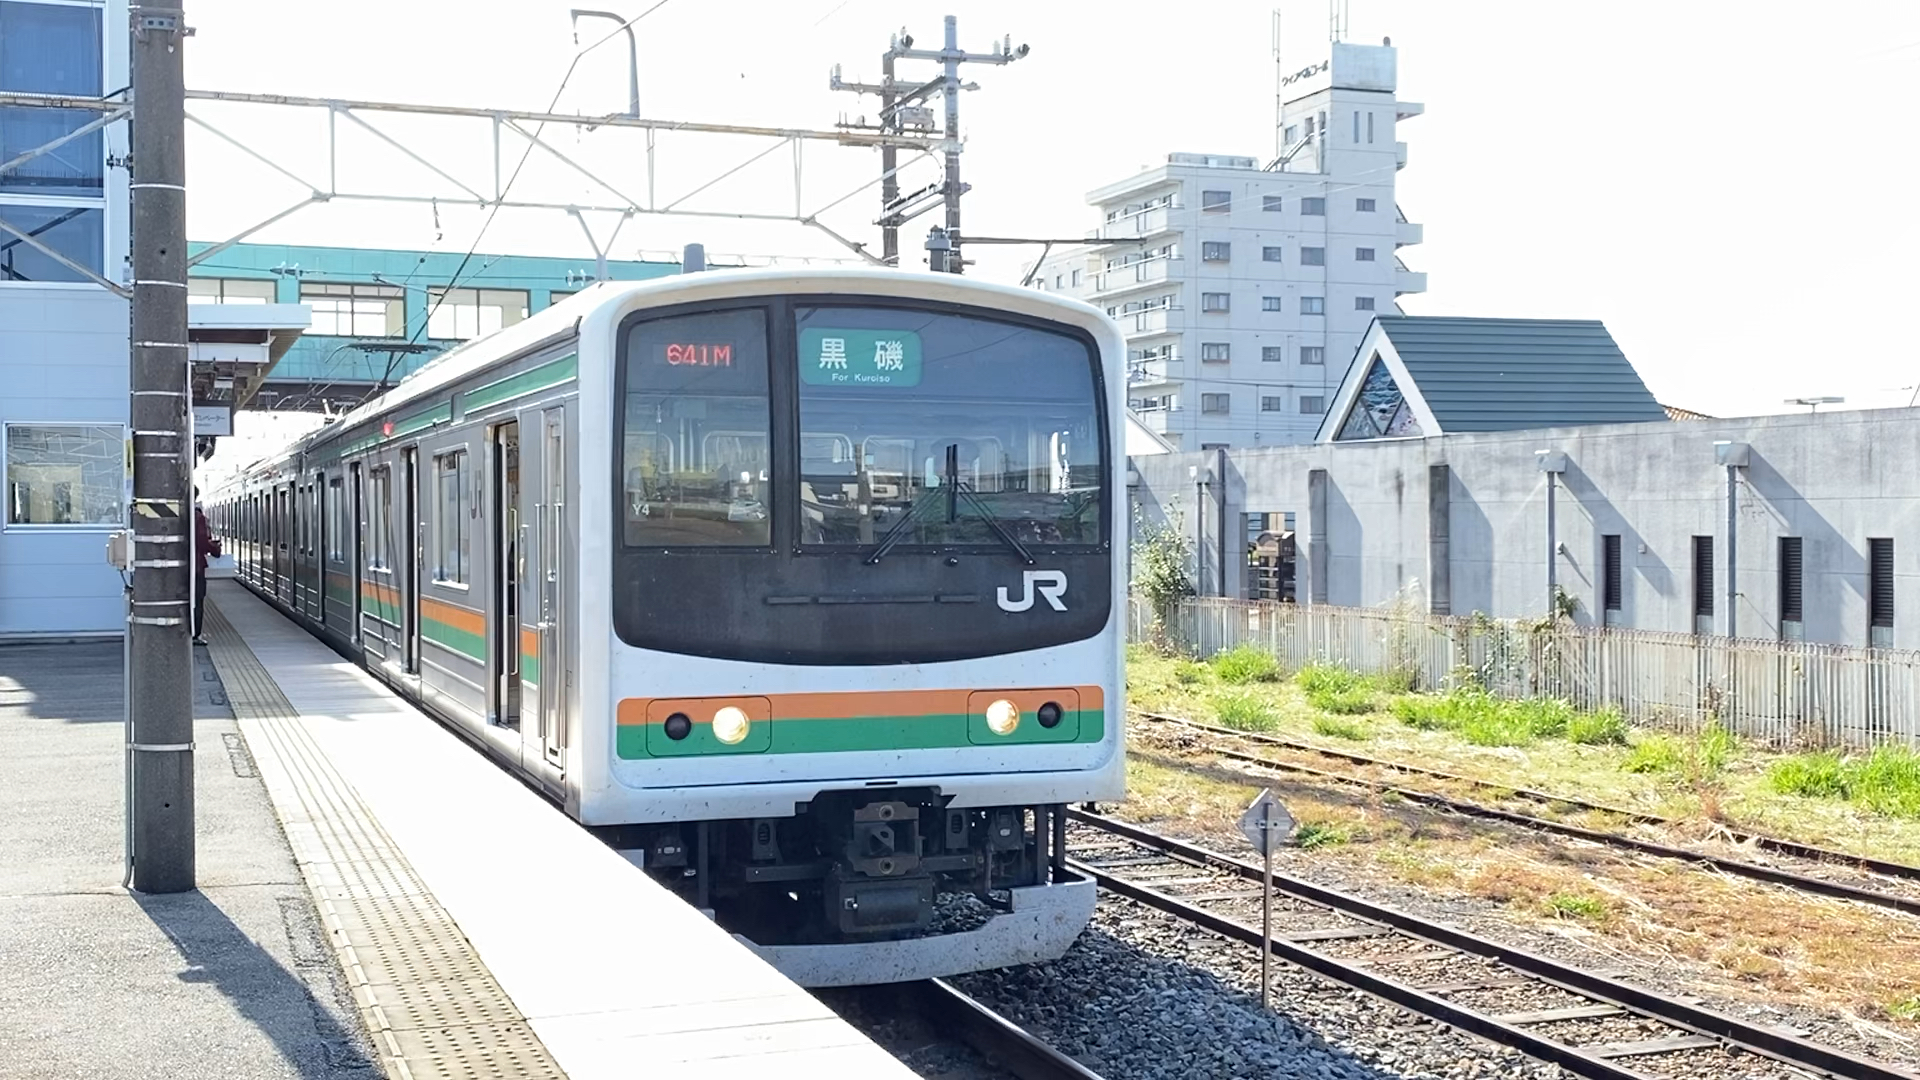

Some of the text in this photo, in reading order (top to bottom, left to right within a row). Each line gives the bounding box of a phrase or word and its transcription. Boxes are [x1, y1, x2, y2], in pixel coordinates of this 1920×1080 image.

[667, 343, 732, 367] 641M
[819, 337, 904, 371] 黒磯
[831, 373, 890, 383] For Kuroiso
[632, 503, 651, 516] Y4
[997, 570, 1068, 613] JR
